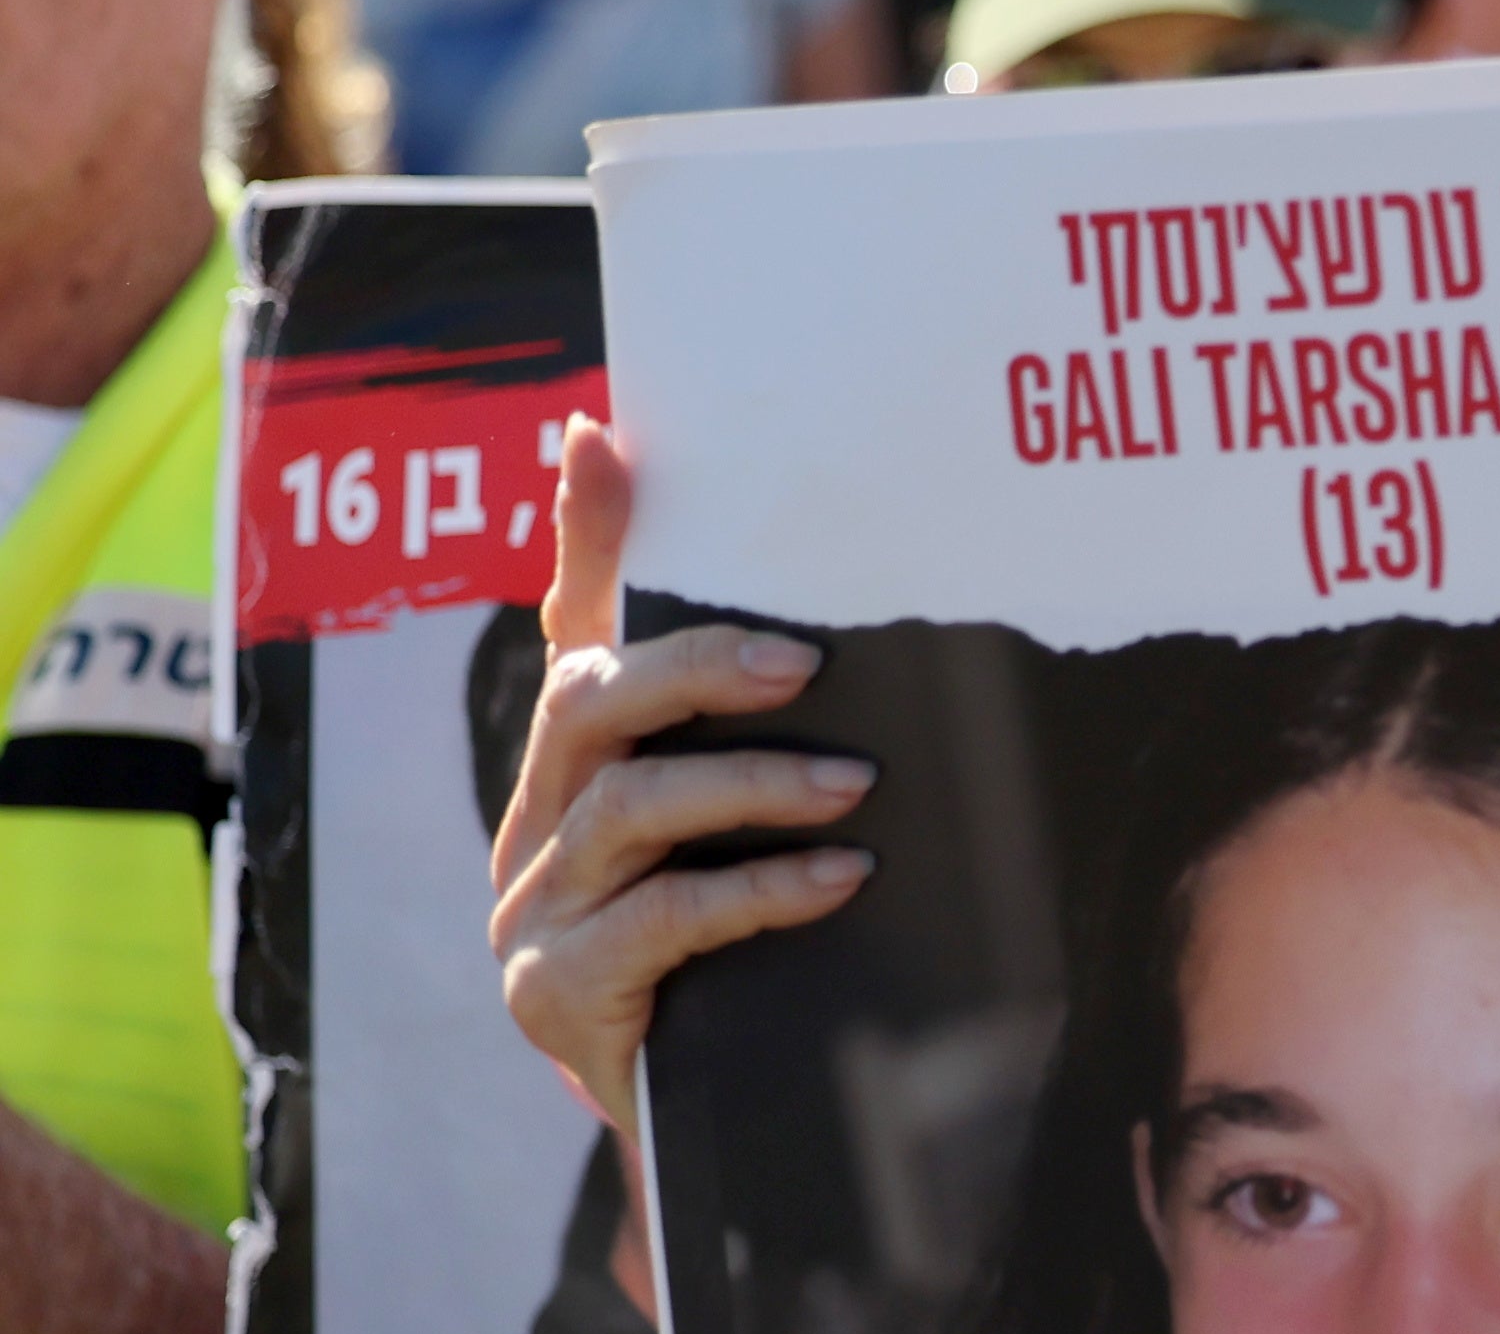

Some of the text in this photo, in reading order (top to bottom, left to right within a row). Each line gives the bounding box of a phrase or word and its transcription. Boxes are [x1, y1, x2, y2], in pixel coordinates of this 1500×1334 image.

[1006, 346, 1179, 466] GALI
[280, 446, 380, 547] 16
[402, 445, 487, 560] בן
[1300, 459, 1445, 597] (13)
